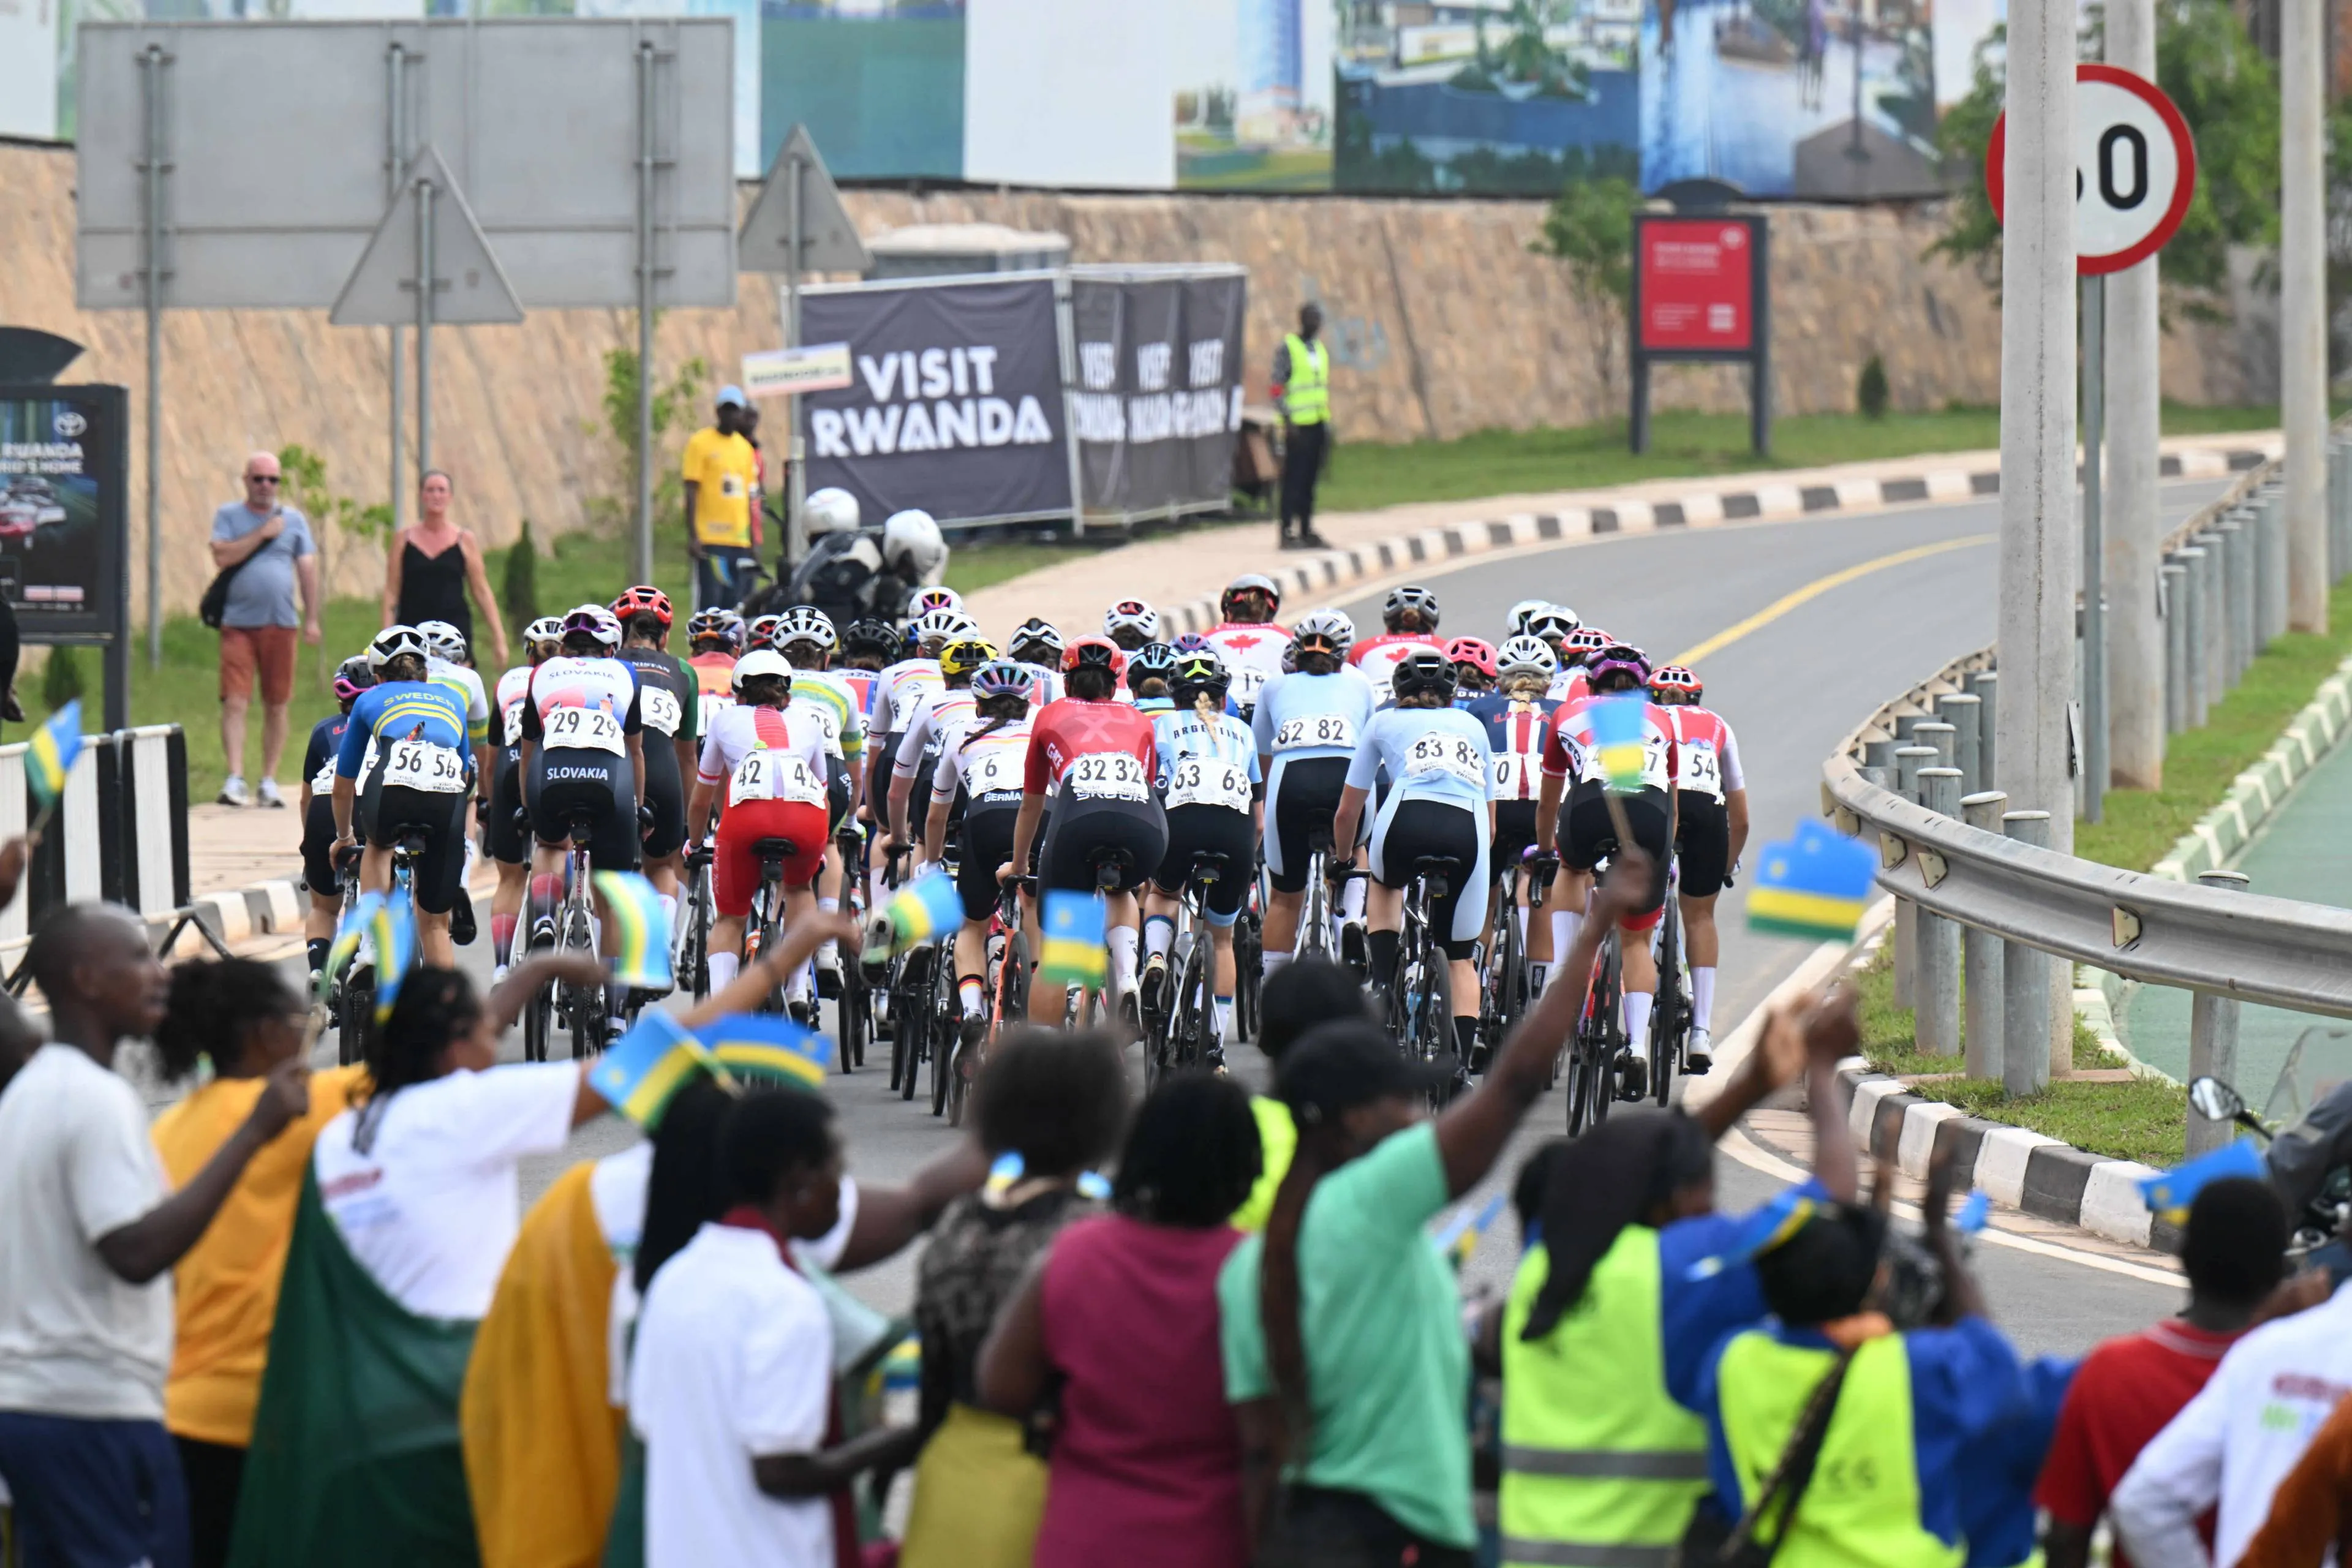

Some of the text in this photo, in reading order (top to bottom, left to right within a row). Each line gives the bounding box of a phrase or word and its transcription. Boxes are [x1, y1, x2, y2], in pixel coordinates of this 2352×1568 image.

[2076, 123, 2148, 209] 0
[859, 345, 997, 402] VISIT
[812, 395, 1054, 458] RWANDA
[652, 696, 674, 721] 55
[554, 711, 580, 733] 29
[593, 715, 616, 738] 29
[1278, 722, 1304, 744] 82
[1317, 719, 1343, 741] 82
[395, 747, 422, 772] 56
[1415, 739, 1443, 760] 83
[432, 754, 456, 779] 56
[547, 767, 608, 781] SLOVAKIA
[737, 760, 761, 786] 42
[984, 758, 997, 777] 6
[1078, 759, 1107, 781] 32
[1115, 759, 1142, 785] 32
[1174, 764, 1200, 790] 63
[1691, 753, 1715, 781] 54
[1223, 769, 1247, 796] 63
